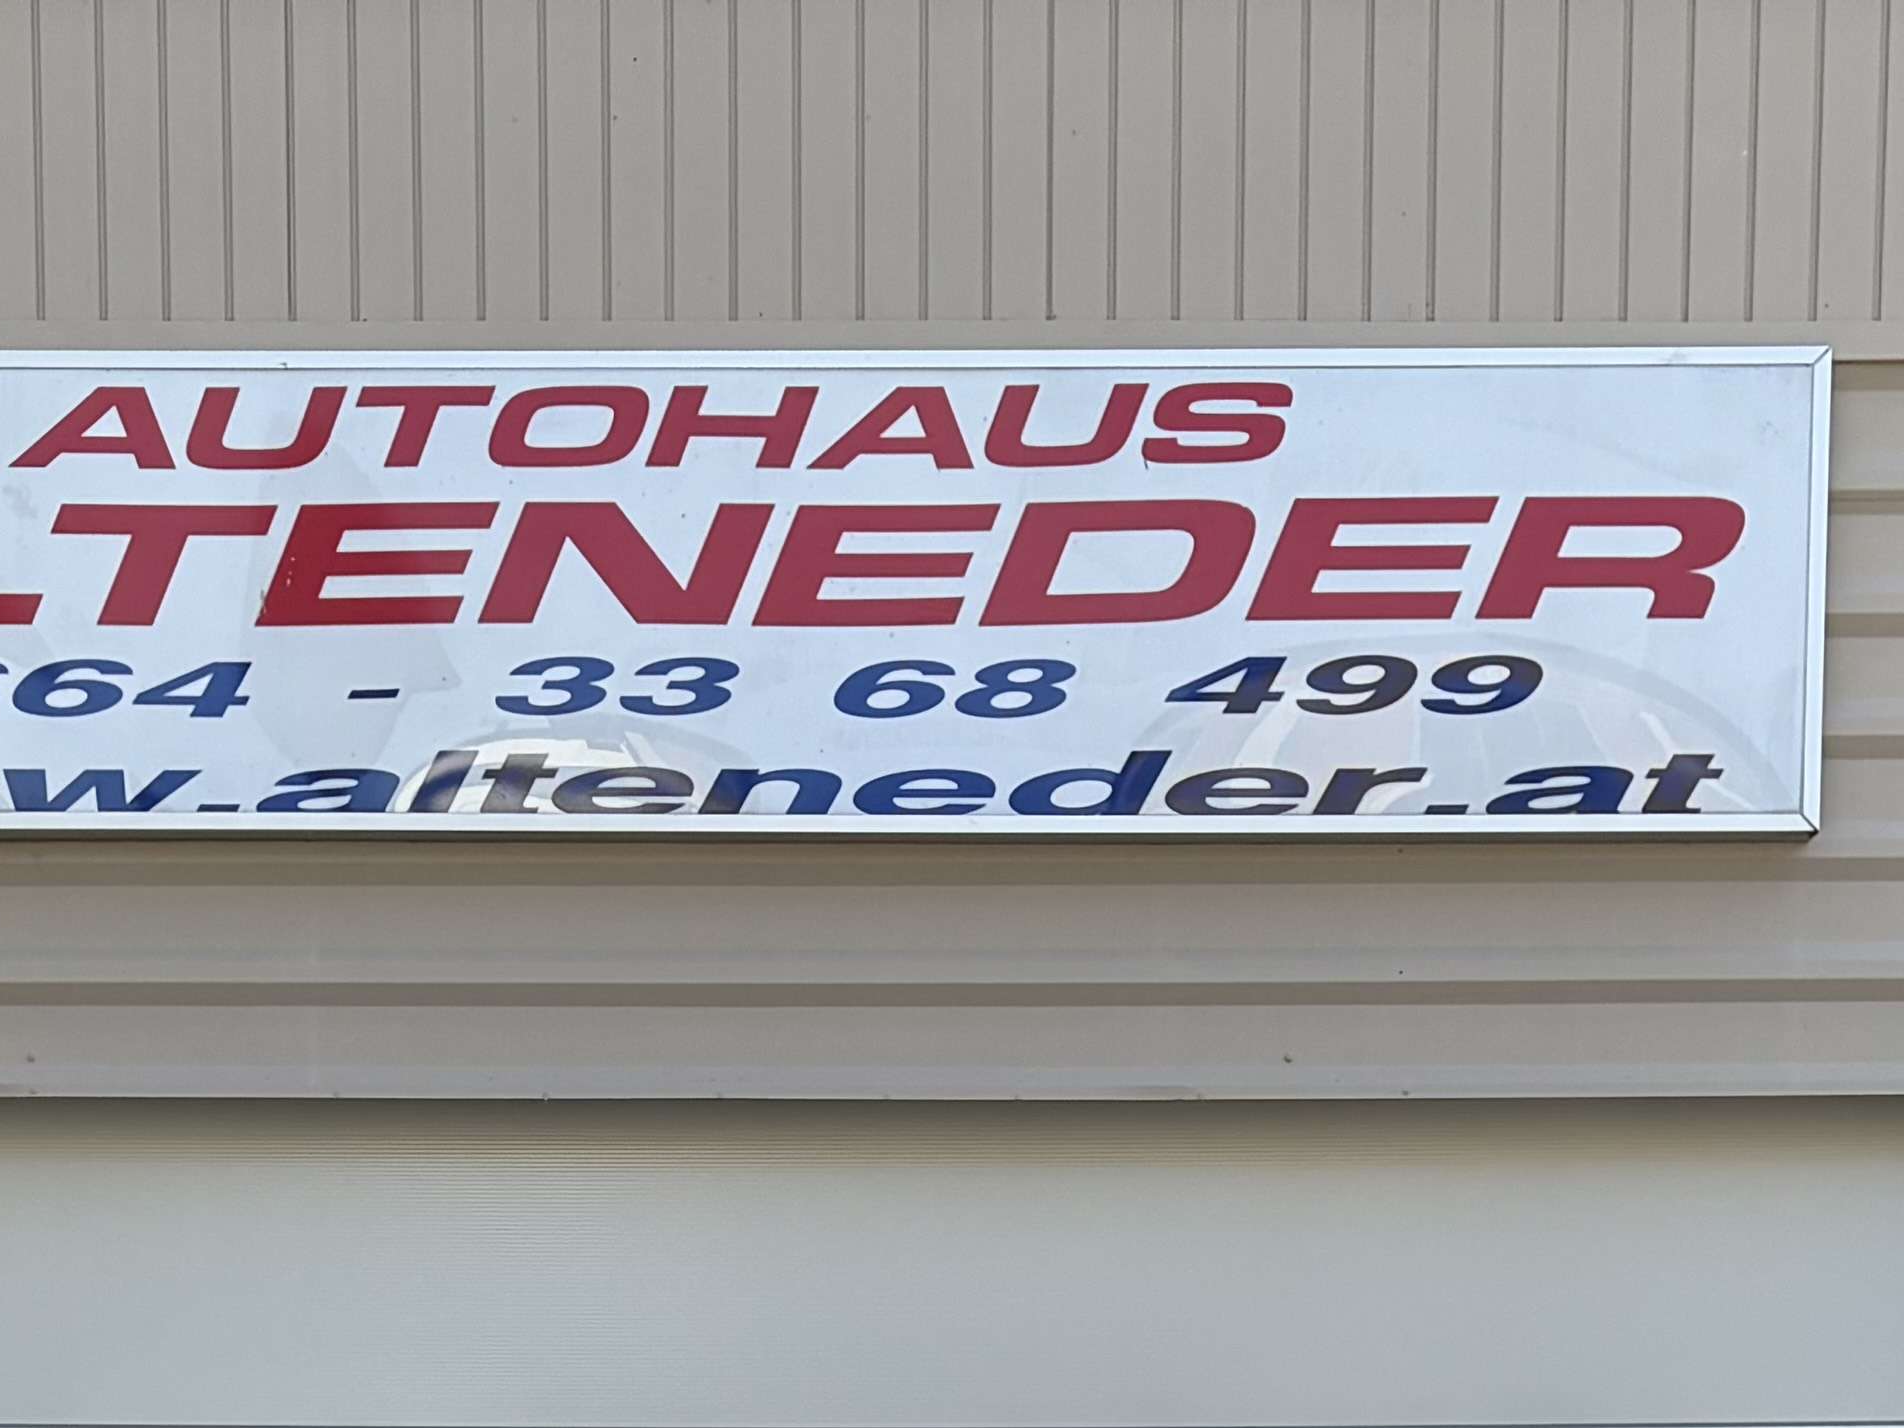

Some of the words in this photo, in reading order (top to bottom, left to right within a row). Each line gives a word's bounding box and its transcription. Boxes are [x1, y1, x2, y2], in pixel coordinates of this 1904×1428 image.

[14, 383, 1292, 470] AUTOHAUS
[495, 656, 740, 716] 33
[833, 659, 1076, 719] 68
[1165, 654, 1544, 716] 499
